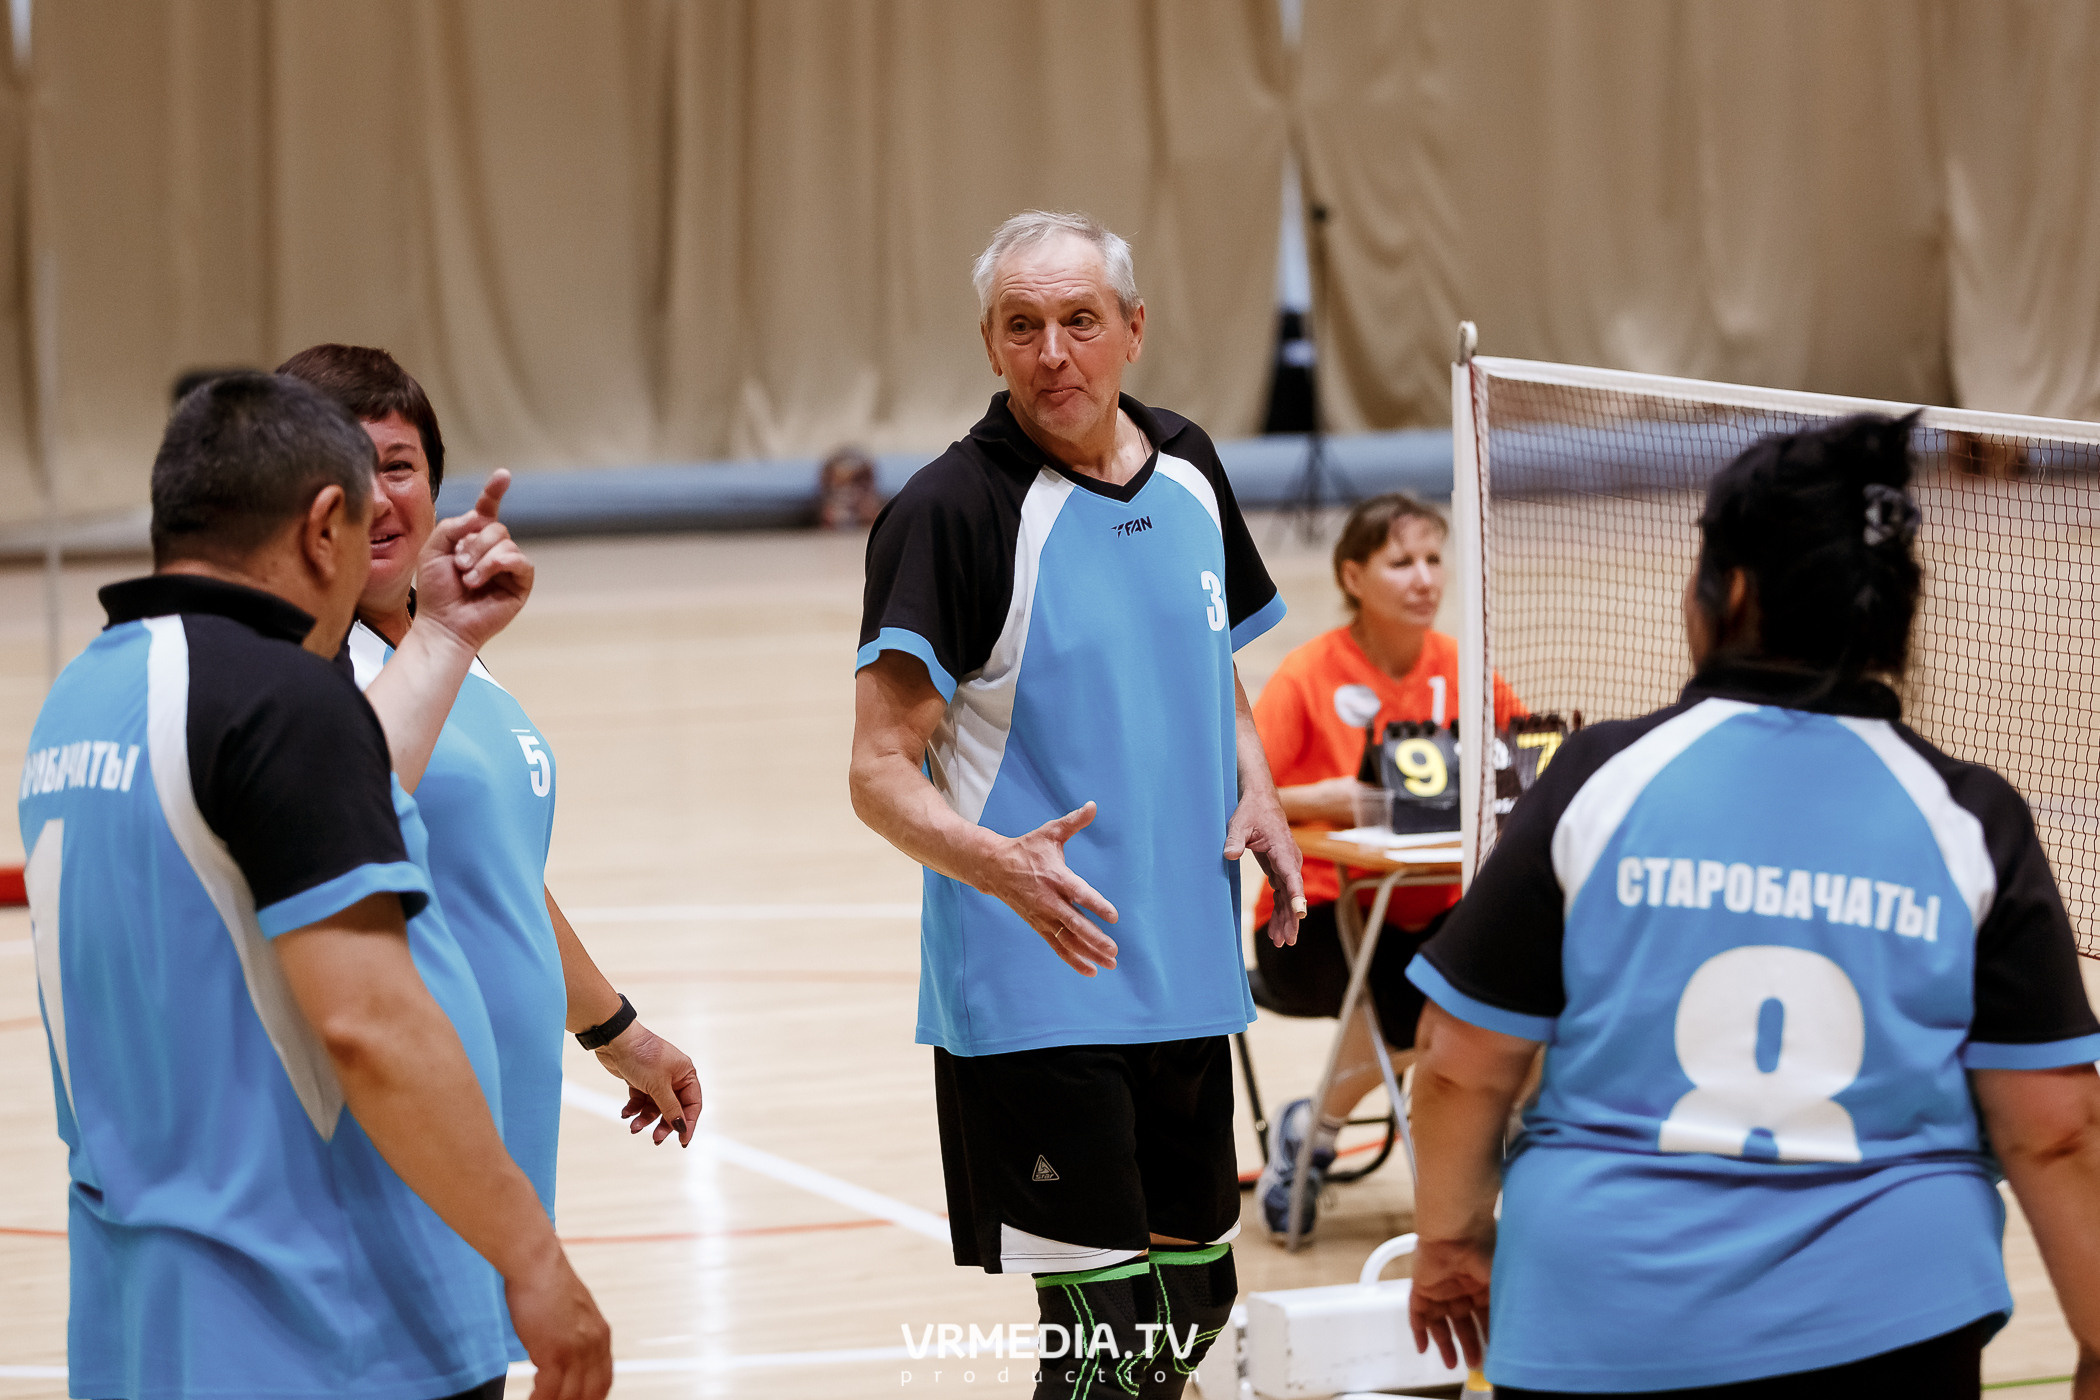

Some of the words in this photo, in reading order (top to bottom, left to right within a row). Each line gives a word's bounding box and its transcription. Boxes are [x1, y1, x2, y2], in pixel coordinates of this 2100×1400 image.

[1200, 570, 1227, 632] 3
[515, 734, 552, 798] 5
[1394, 737, 1449, 798] 9
[1515, 731, 1564, 780] 7
[1616, 857, 1941, 942] СТАРОБАЧАТЫ
[1658, 945, 1864, 1162] 8
